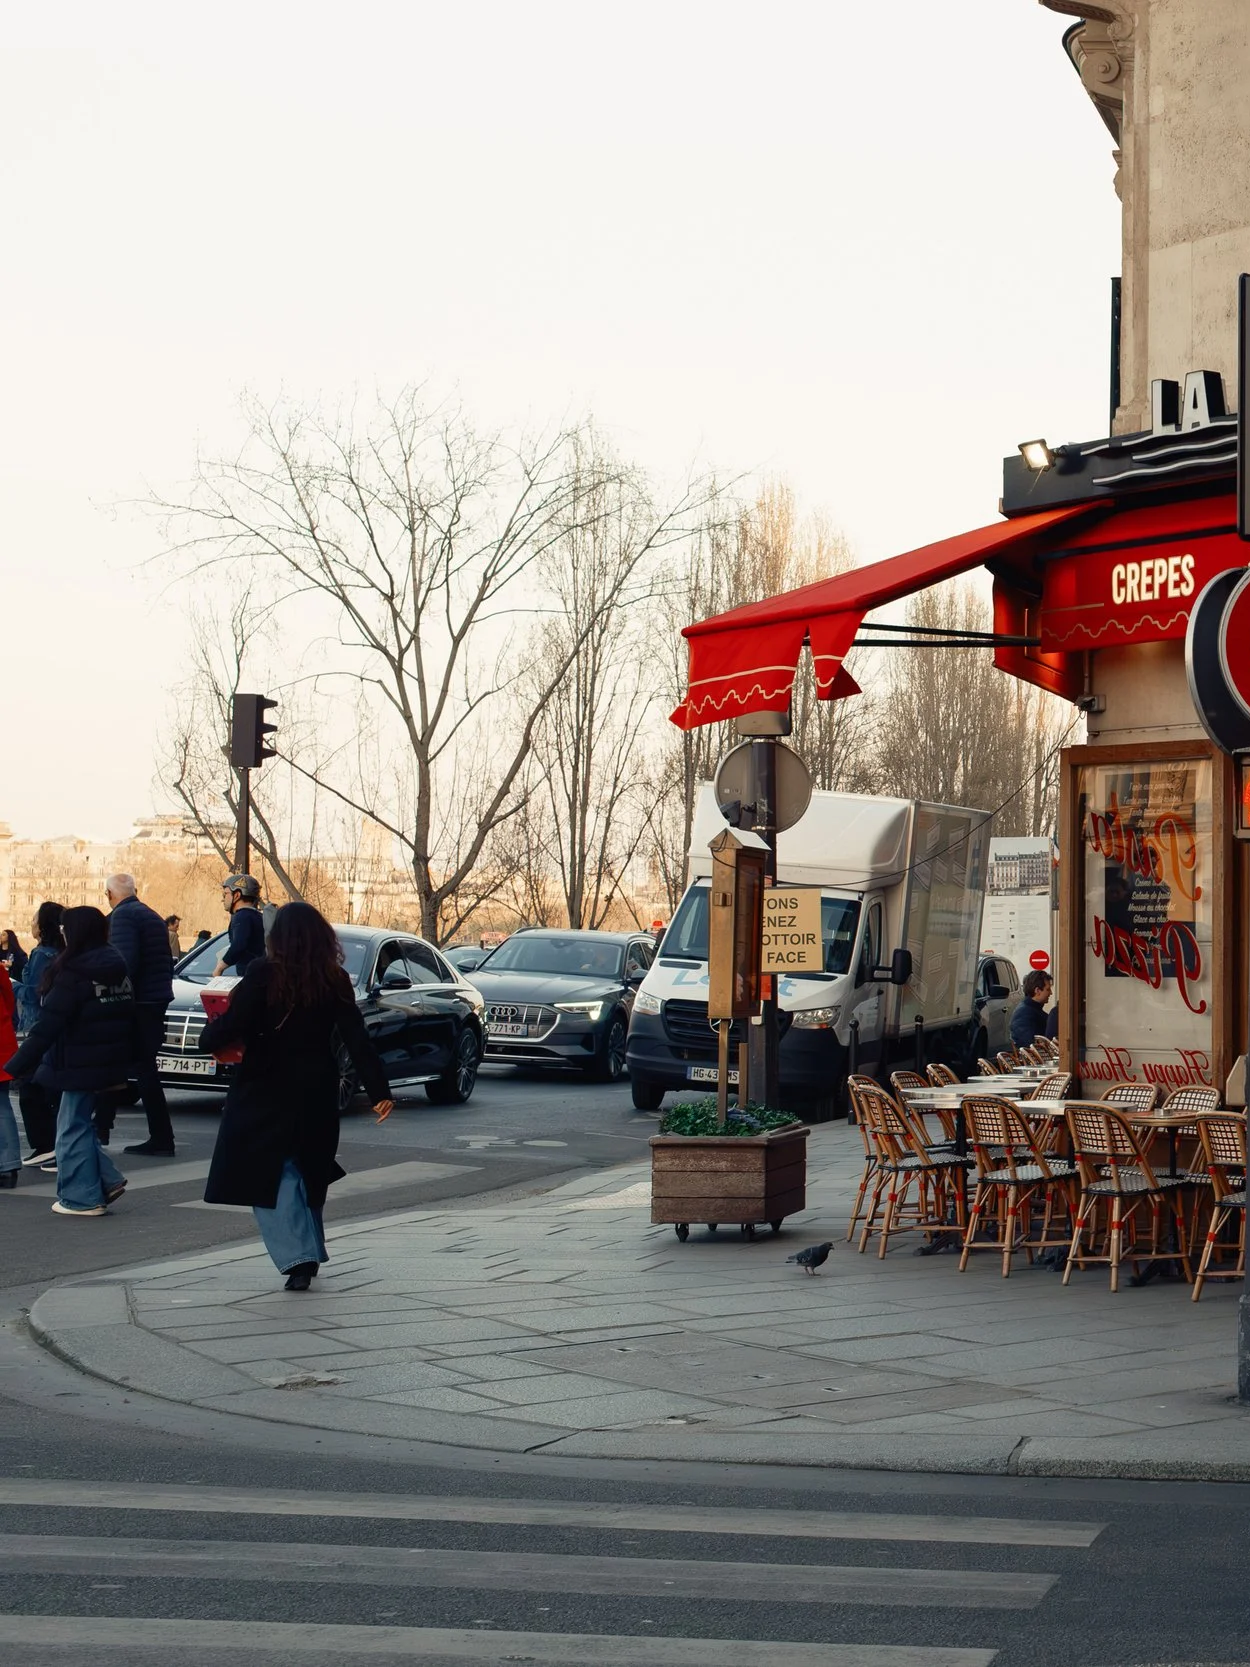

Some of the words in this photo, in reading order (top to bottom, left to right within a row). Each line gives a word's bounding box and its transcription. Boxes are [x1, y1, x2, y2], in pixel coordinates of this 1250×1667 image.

[1152, 370, 1214, 435] LA
[1112, 554, 1195, 605] CREPES
[767, 952, 806, 963] FACE
